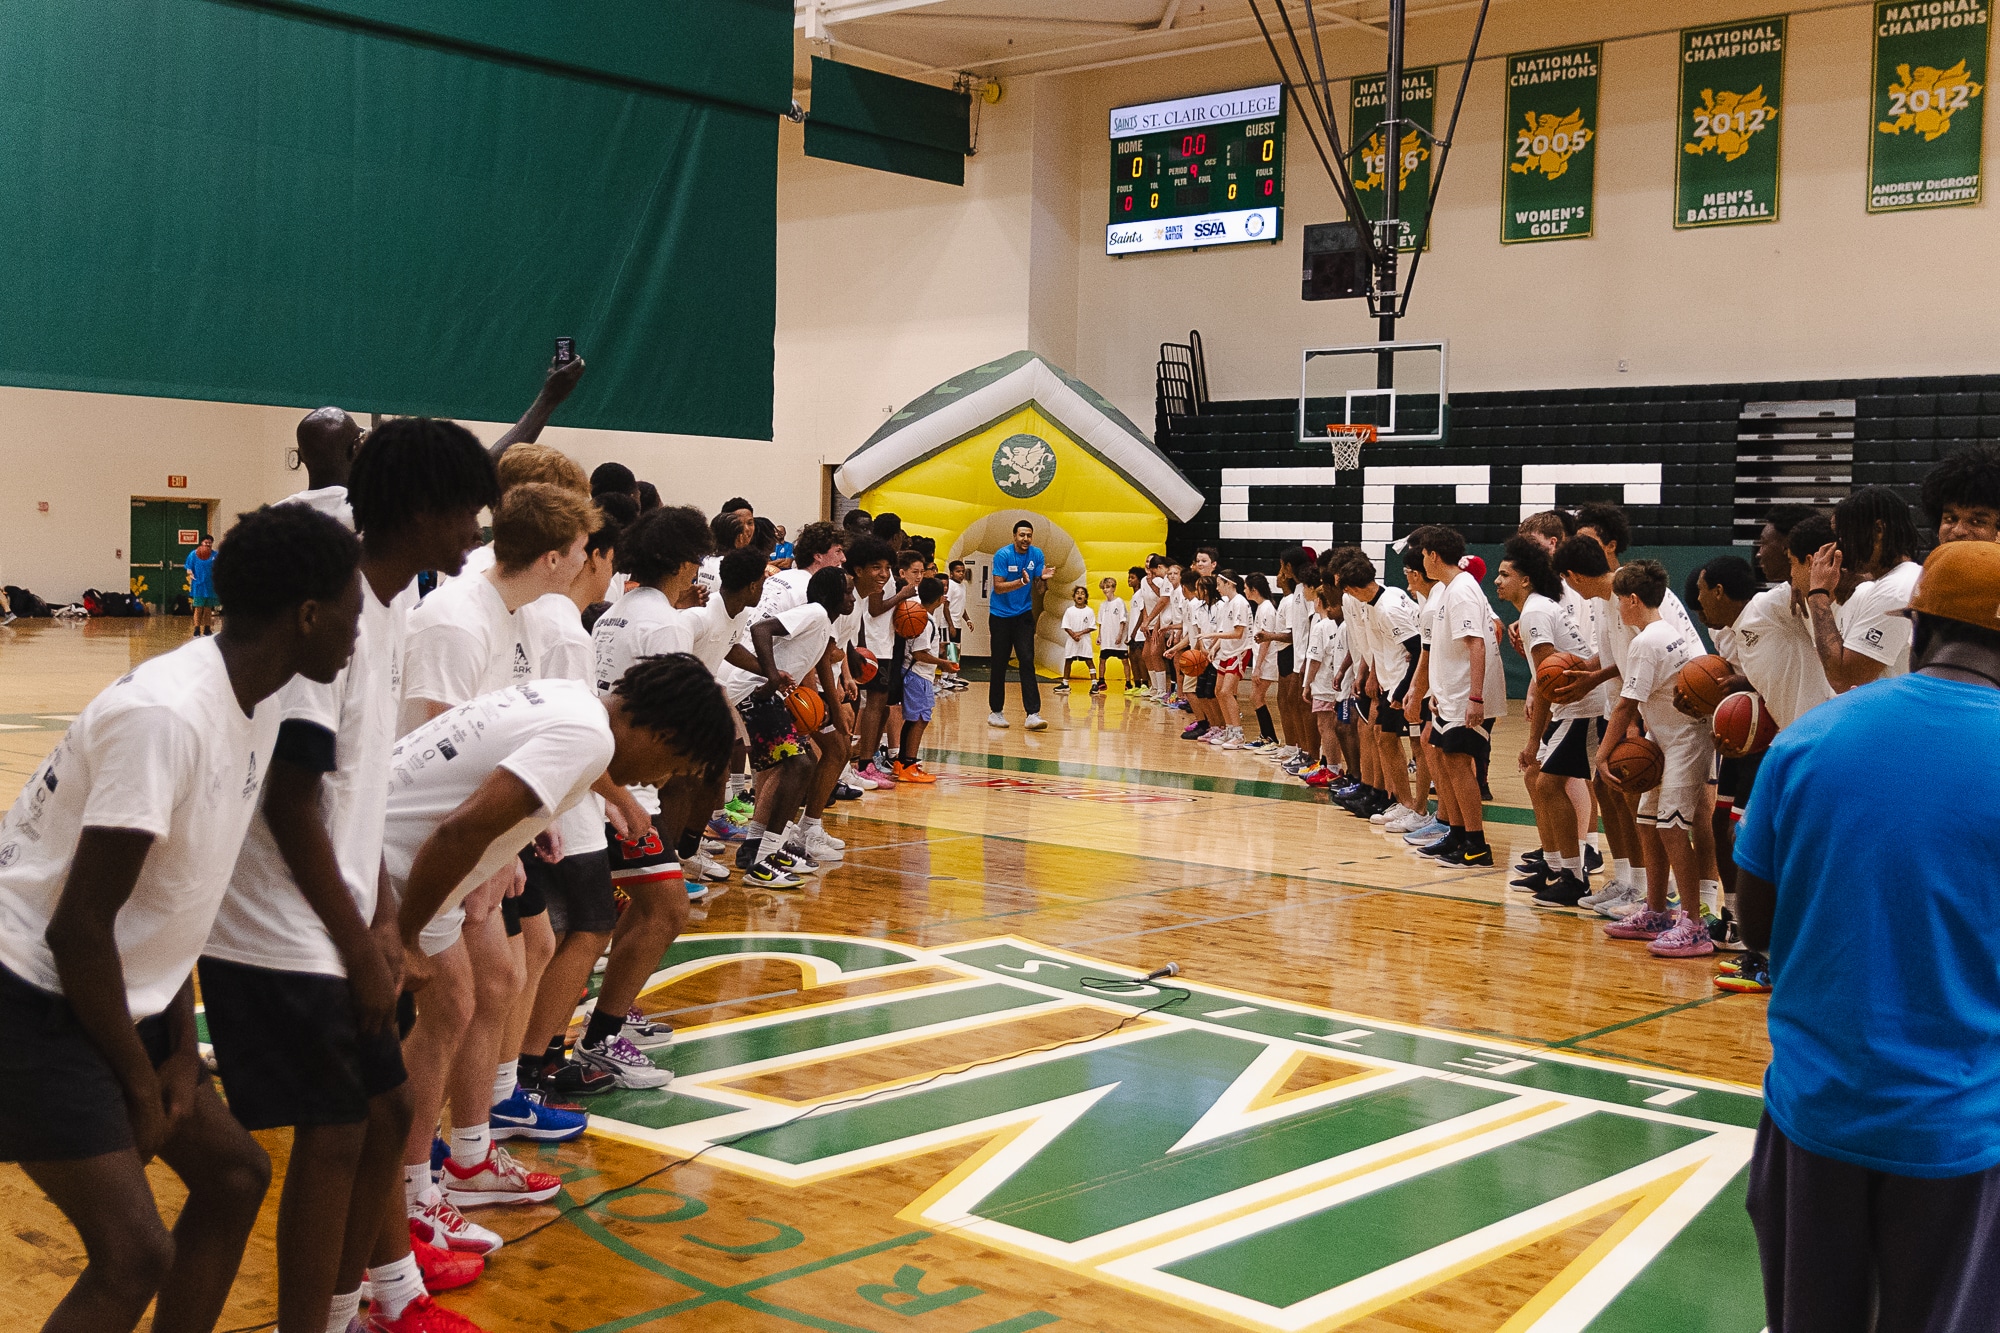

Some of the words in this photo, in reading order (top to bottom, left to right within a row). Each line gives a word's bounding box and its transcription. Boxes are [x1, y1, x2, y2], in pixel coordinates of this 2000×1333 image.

[1885, 0, 1980, 21] NATIONAL
[1878, 10, 1987, 37] CHAMPIONS
[1691, 26, 1775, 48] NATIONAL
[1684, 39, 1782, 63] CHAMPIONS
[1516, 52, 1591, 73] NATIONAL
[1510, 64, 1598, 87] CHAMPIONS
[1360, 76, 1427, 95] NATNAL
[1354, 87, 1433, 108] CHAIONS
[1888, 85, 1969, 116] 2012
[1114, 115, 1138, 131] SAINTS
[1142, 114, 1161, 129] ST.
[1164, 107, 1206, 125] CLAIR
[1210, 96, 1276, 121] COLLEGE
[1245, 121, 1276, 137] GUEST
[1693, 108, 1766, 138] 2012
[1117, 139, 1143, 154] HOME
[1262, 139, 1274, 162] 0
[1515, 130, 1586, 158] 2005
[1131, 157, 1143, 178] 0
[1168, 166, 1188, 176] PERIOD
[1363, 150, 1418, 174] 196
[1198, 175, 1212, 184] FOUL
[1255, 167, 1273, 177] FOULS
[1116, 184, 1133, 194] FOULS
[1227, 183, 1237, 200] 0
[1263, 179, 1274, 196] 0
[1872, 180, 1923, 195] ANDREW
[1124, 195, 1133, 211] 0
[1150, 192, 1159, 208] 0
[1702, 189, 1753, 207] MEN'S
[1871, 193, 1914, 207] CROSS
[1916, 187, 1978, 204] COUNTRY
[1515, 206, 1585, 224] WOMEN'S
[1687, 203, 1769, 222] BASEBALL
[1165, 224, 1183, 233] SAINTS
[1165, 232, 1183, 241] NATION
[1194, 221, 1226, 238] SSAA
[1530, 222, 1568, 236] GOLF
[1109, 231, 1143, 246] Saints
[513, 665, 532, 674] ARK
